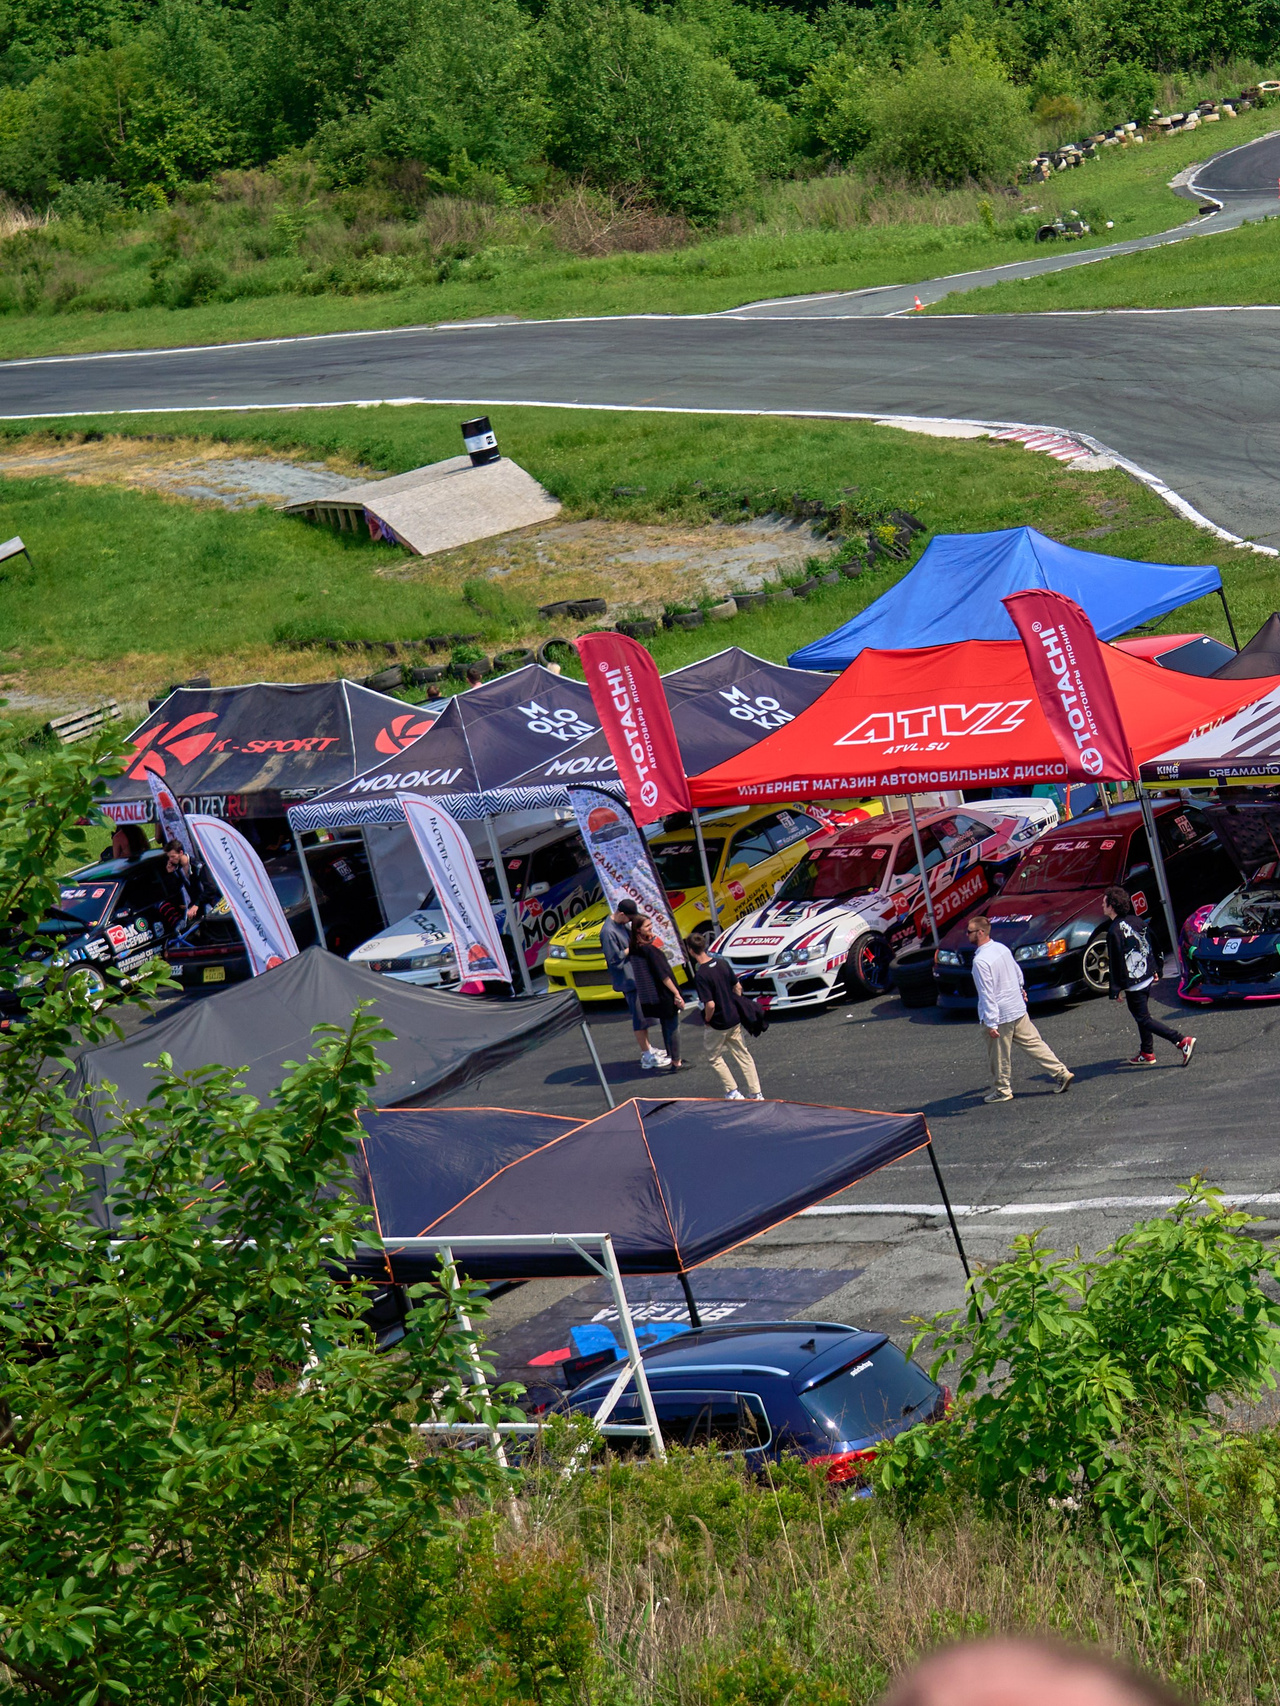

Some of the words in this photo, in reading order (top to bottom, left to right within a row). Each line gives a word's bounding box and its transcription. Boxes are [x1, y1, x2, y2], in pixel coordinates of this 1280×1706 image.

[1058, 624, 1077, 666] ЯПОНИЯ
[624, 665, 641, 703] ЯПОНИЯ
[719, 686, 749, 706] M
[1039, 628, 1090, 749] TOTACHI
[518, 701, 548, 720] M
[1073, 669, 1098, 736] АВТОТОВАРЫ
[605, 668, 649, 782] TOTACHI
[834, 699, 1033, 746] ATVL
[637, 707, 657, 769] АВТОТОВАРЫ
[882, 741, 951, 756] ATVL.SU
[545, 754, 619, 776] MOLO
[1157, 765, 1179, 774] KING
[349, 768, 464, 793] MOLOKAI
[738, 779, 809, 797] ИНТЕРНЕТ
[813, 775, 878, 792] МАГАЗИН
[880, 767, 1010, 788] АВТОМОБИЛЬНЫХ
[103, 804, 145, 822] WANLI
[110, 930, 124, 942] FQ
[1225, 941, 1239, 951] FQ
